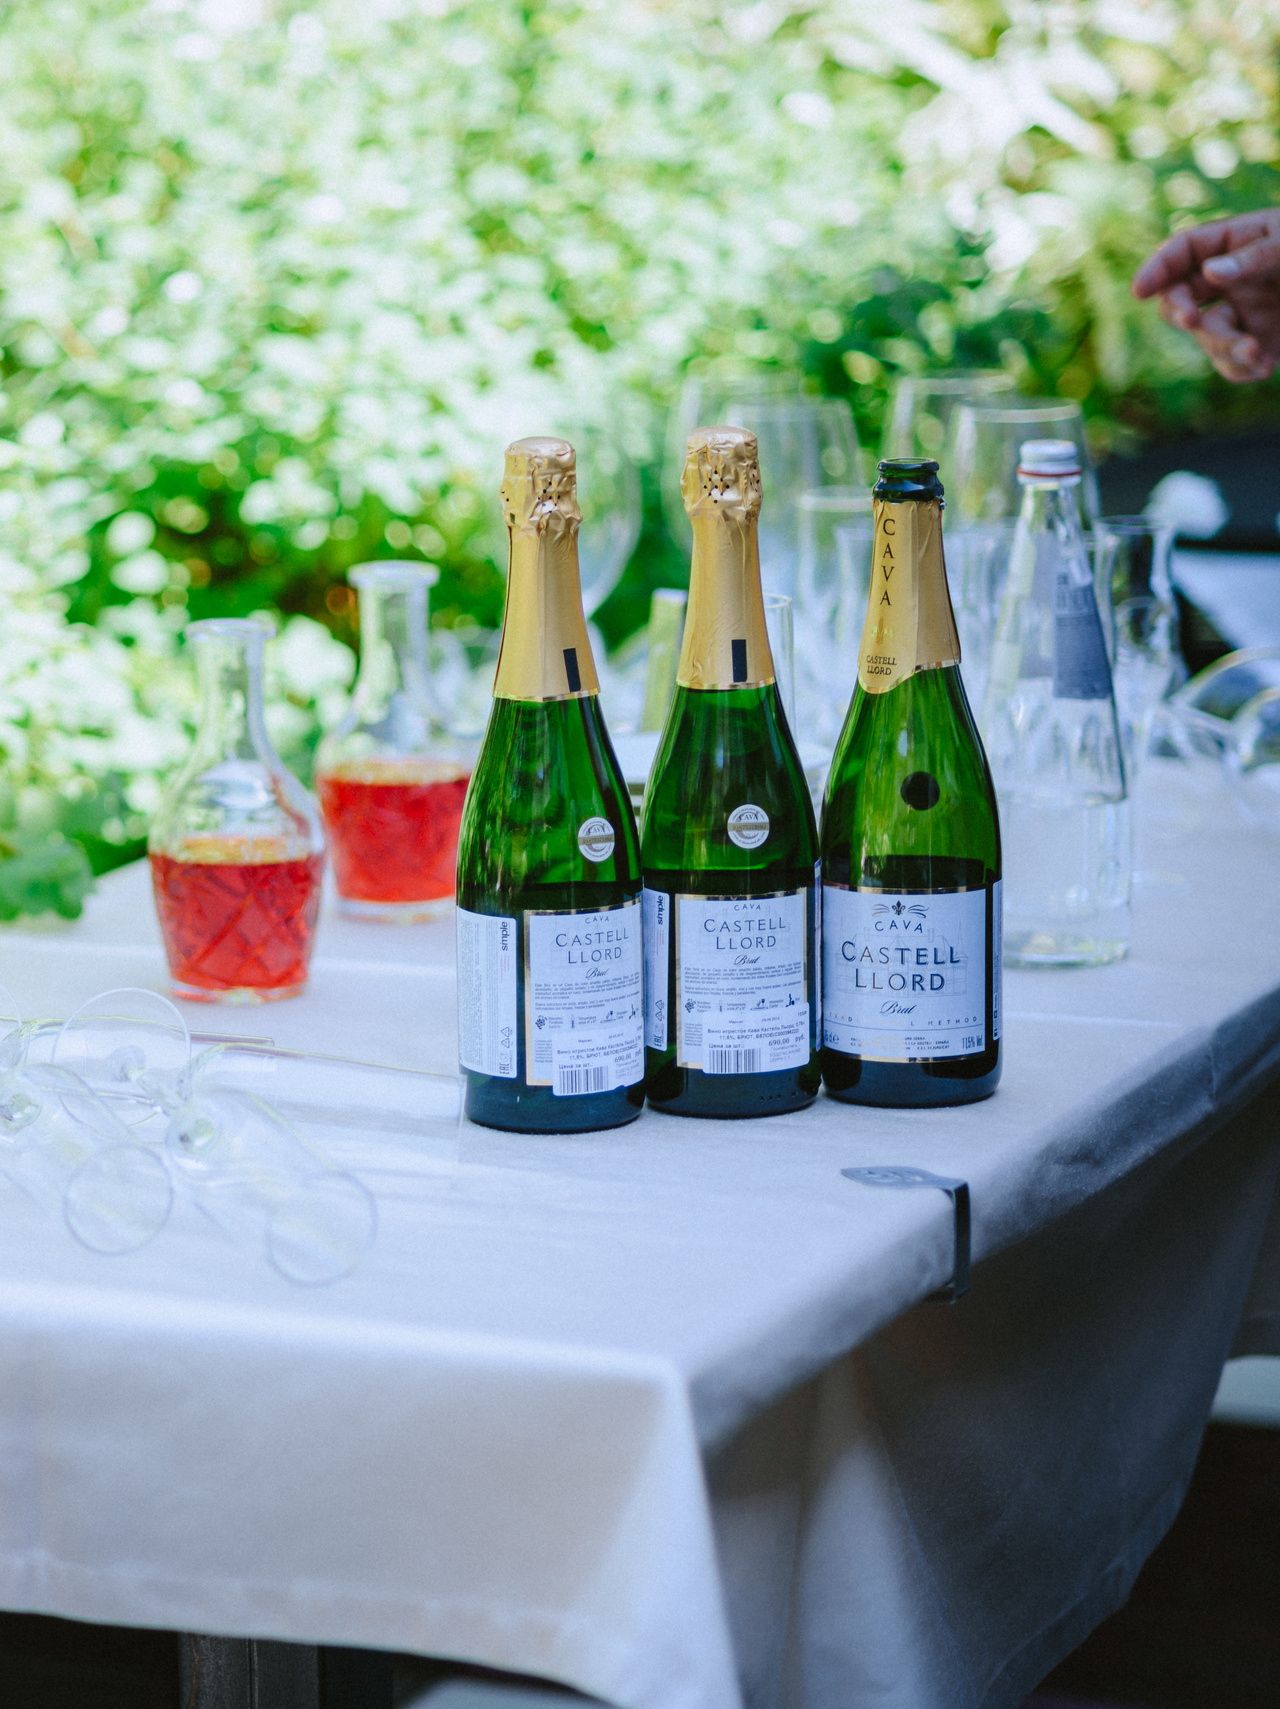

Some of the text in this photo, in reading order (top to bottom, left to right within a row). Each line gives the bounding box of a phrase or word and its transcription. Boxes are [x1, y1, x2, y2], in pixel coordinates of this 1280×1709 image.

[879, 518, 896, 606] CAVA
[866, 654, 898, 666] CASTELL
[866, 665, 892, 676] LLORD
[734, 903, 762, 912] CAVA
[584, 915, 611, 925] CAVA
[703, 917, 787, 933] CASTELL
[874, 919, 924, 934] CAVA
[555, 927, 629, 948] CASTELL
[715, 935, 777, 950] LLORD
[568, 946, 623, 965] LLORD
[733, 954, 761, 966] Brut
[841, 940, 961, 966] CASTELL
[584, 967, 610, 980] Brut
[855, 968, 946, 992] LLORD
[879, 1000, 918, 1016] Brut
[927, 1016, 978, 1027] METHOD
[768, 1038, 790, 1047] 690.00
